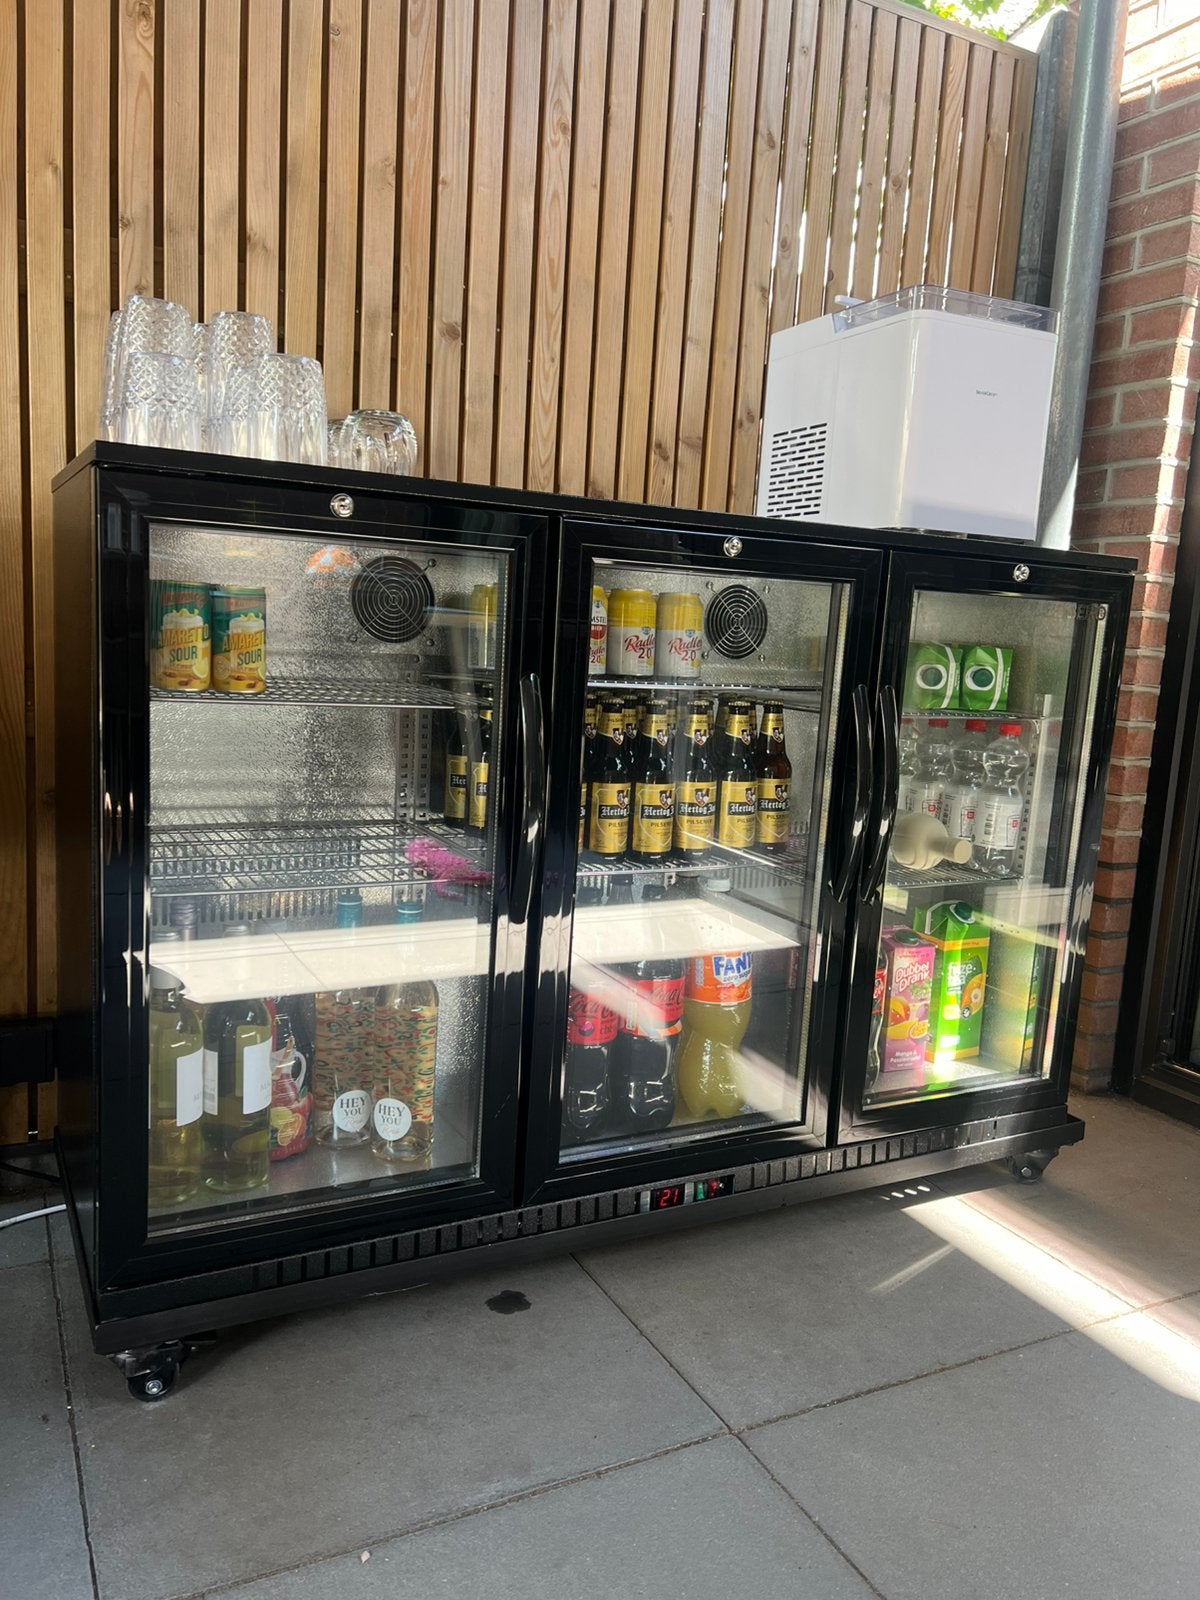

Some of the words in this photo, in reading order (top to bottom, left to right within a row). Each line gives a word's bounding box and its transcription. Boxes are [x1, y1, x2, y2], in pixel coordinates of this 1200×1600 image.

[169, 645, 198, 662] SOUR
[237, 648, 262, 667] SOUR
[600, 806, 627, 817] Hertog
[643, 806, 670, 818] Hertog
[678, 803, 708, 815] Hertog
[713, 951, 752, 976] FANT
[340, 1095, 368, 1109] HEY
[378, 1104, 405, 1117] HEY
[381, 1115, 402, 1126] YOU
[660, 1188, 679, 1207] 21
